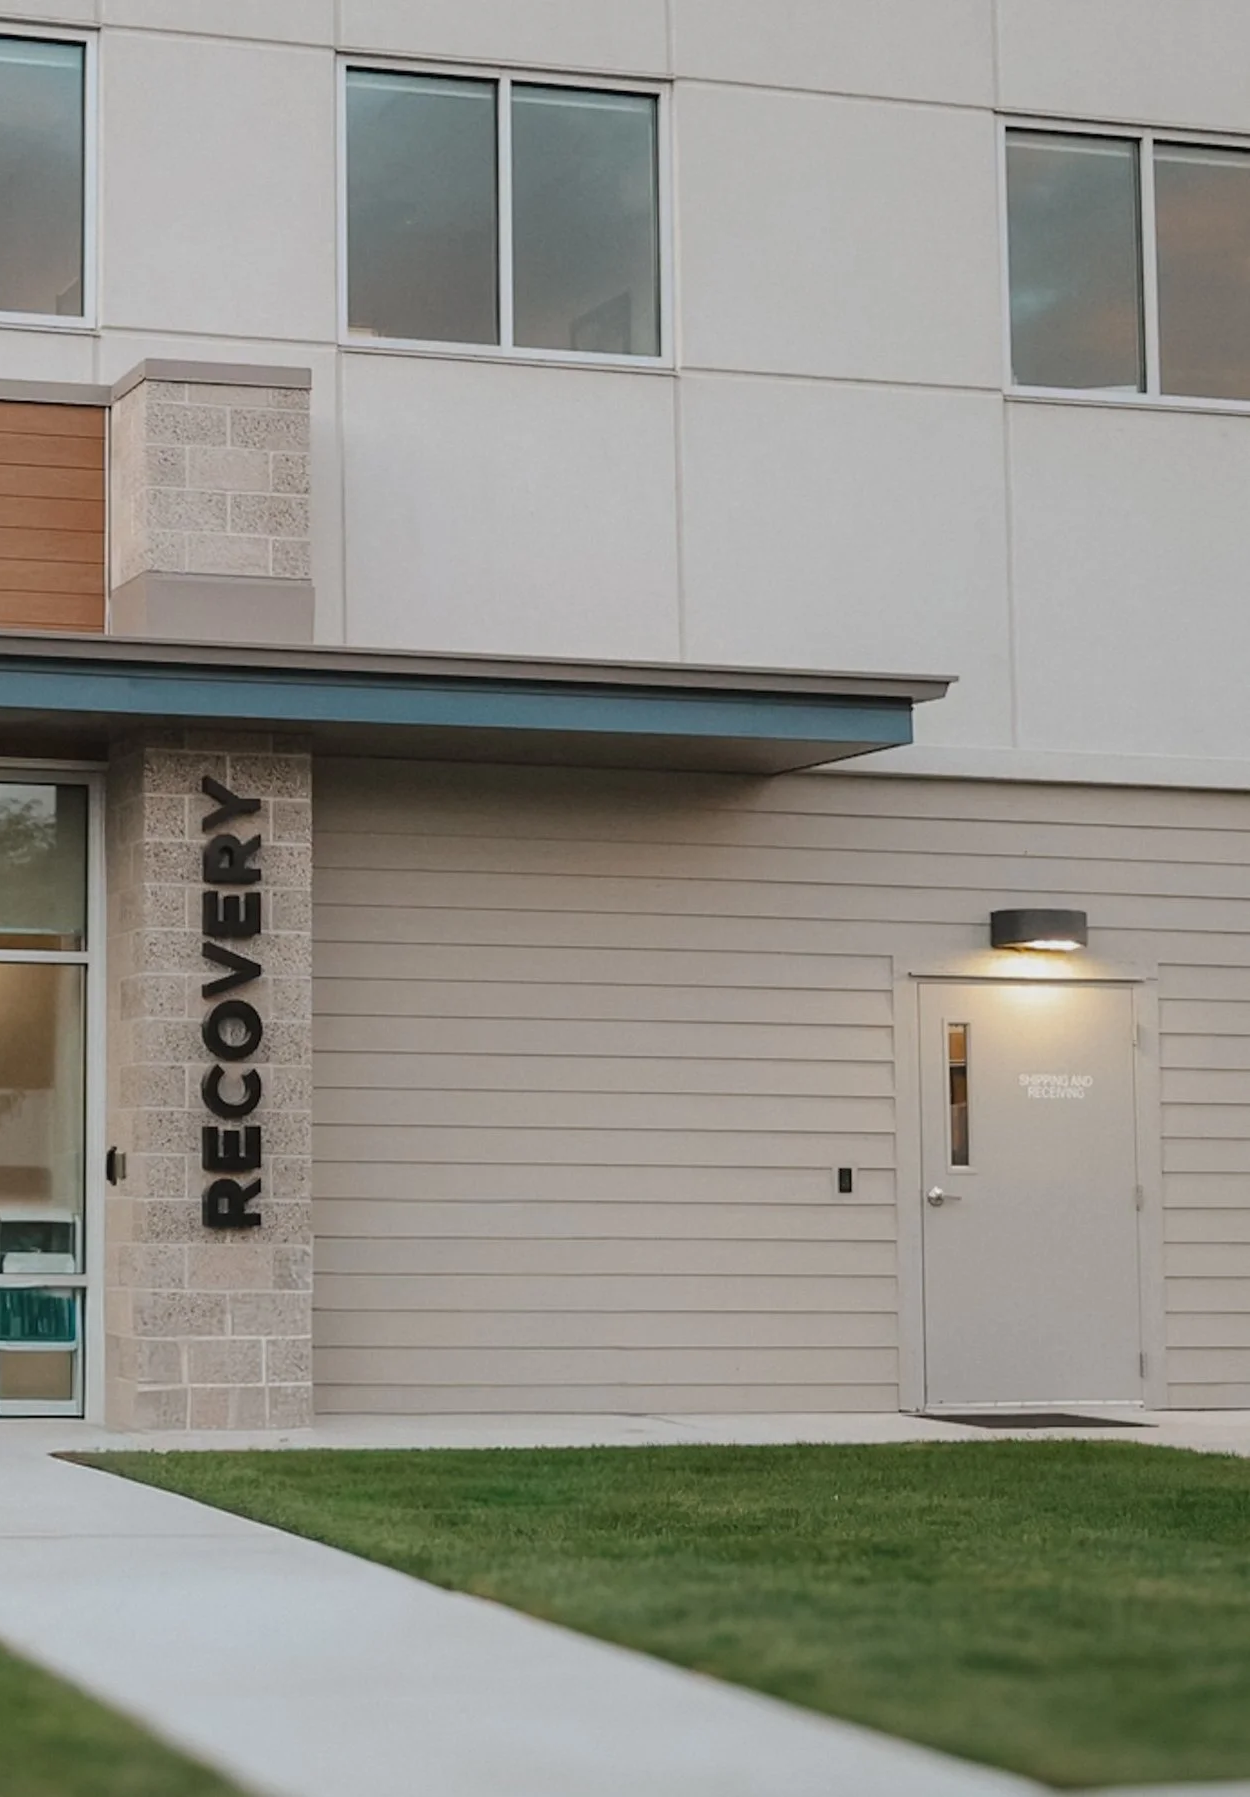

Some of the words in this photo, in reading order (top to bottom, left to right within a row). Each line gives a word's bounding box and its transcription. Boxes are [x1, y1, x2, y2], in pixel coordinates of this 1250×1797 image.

[202, 775, 263, 1228] RECOVERY
[1018, 1074, 1068, 1087] SHIPPING
[1070, 1074, 1094, 1087] AND
[1027, 1086, 1086, 1099] RECEIVING
